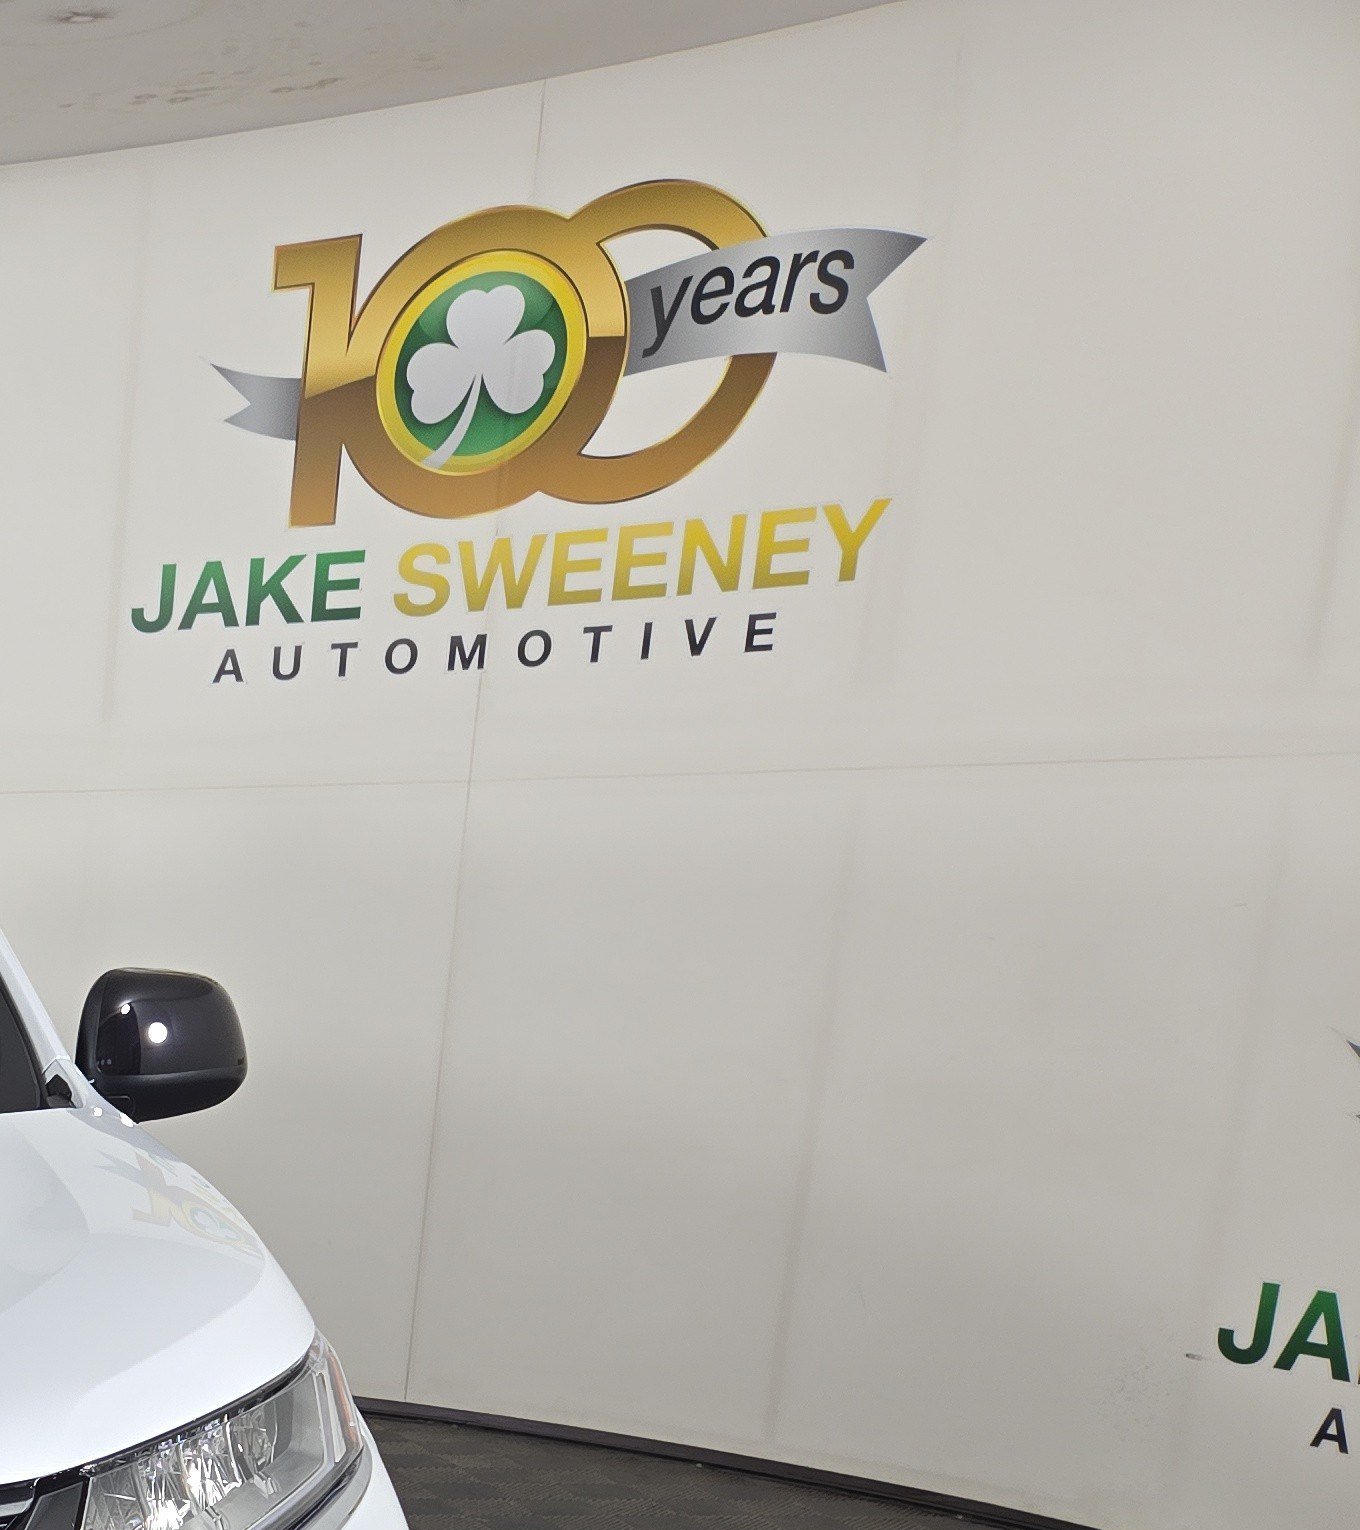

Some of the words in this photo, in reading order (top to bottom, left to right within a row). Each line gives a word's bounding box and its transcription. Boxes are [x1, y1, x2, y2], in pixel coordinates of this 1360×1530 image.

[642, 249, 856, 359] years
[131, 549, 367, 634] JAKE
[392, 497, 892, 617] SWEENEY
[212, 611, 778, 685] AUTOMOTIVE
[1217, 1281, 1360, 1384] JA
